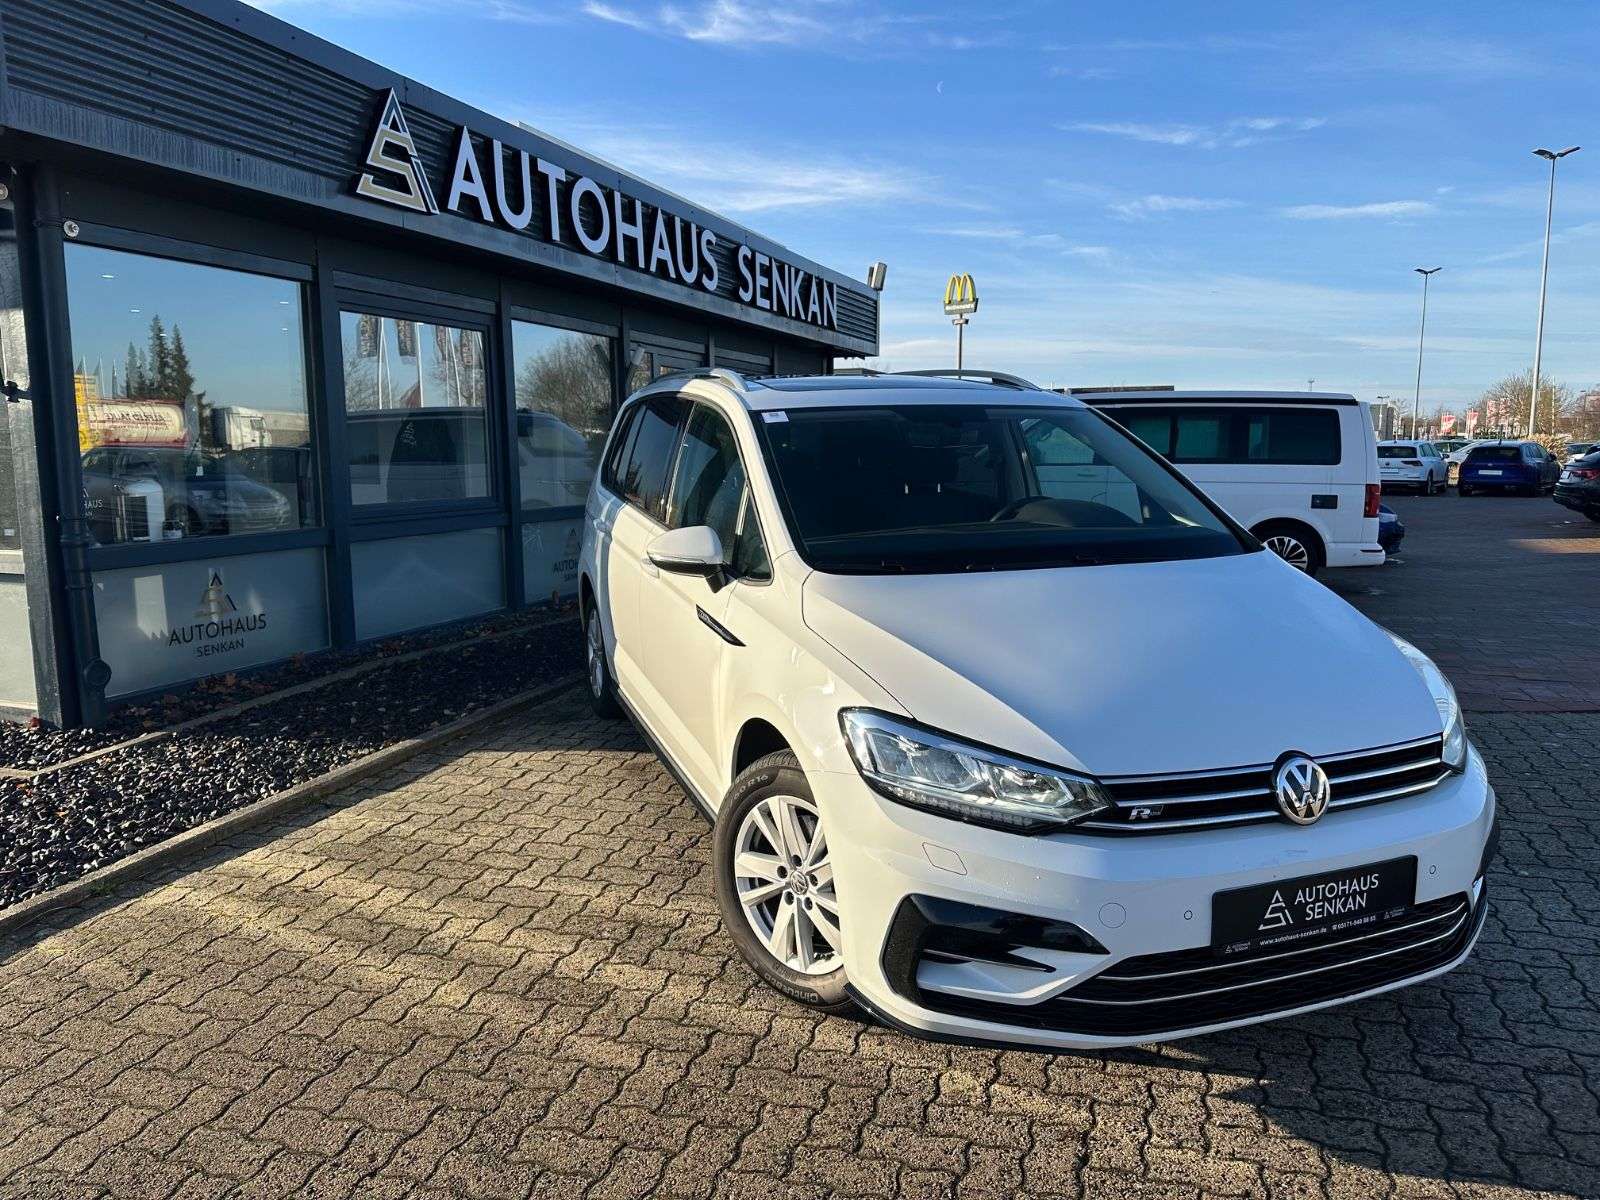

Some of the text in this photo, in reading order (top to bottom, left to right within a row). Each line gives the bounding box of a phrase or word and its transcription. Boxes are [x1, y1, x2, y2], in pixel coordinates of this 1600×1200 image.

[447, 125, 838, 331] AUTOHAUS SENKAN
[168, 613, 267, 647] AUTOHAUS
[196, 638, 245, 658] SENKAN
[1294, 873, 1379, 905] AUTOHAUS
[1305, 893, 1367, 921] SENKAN
